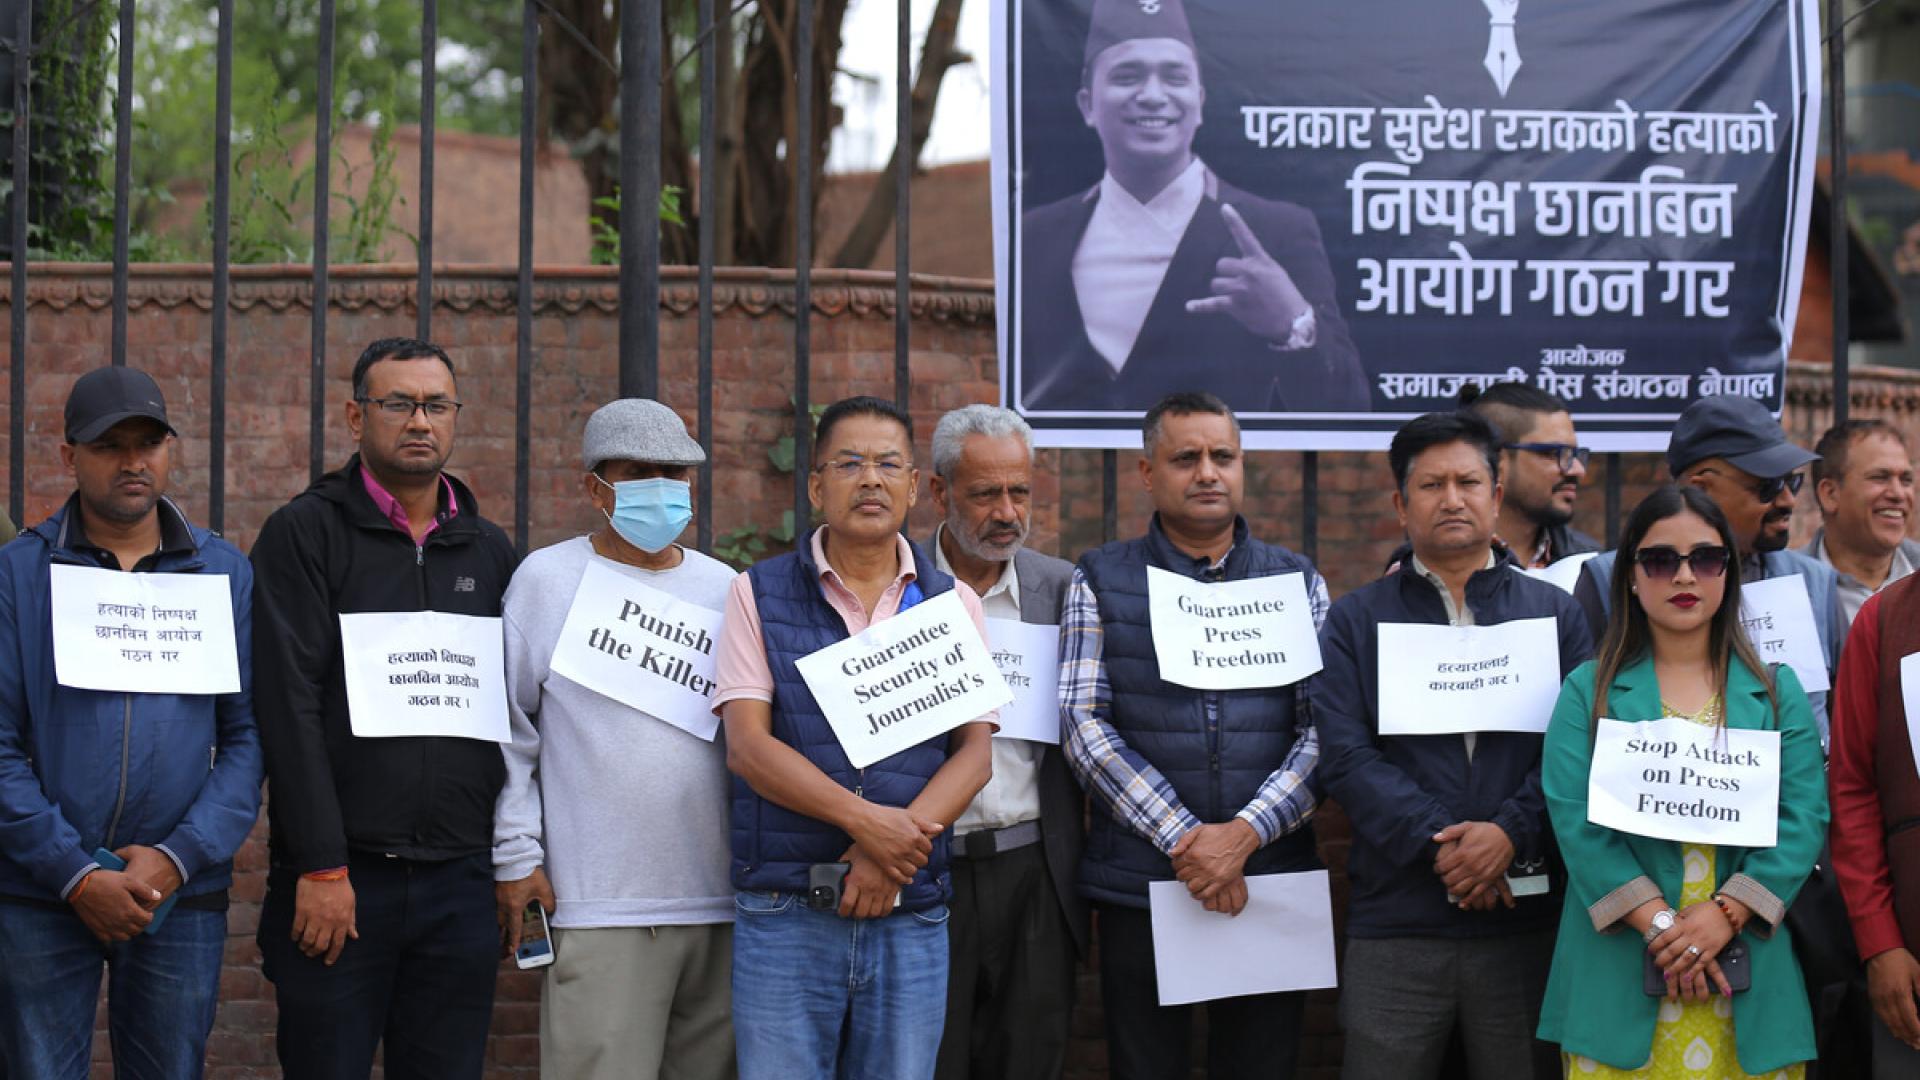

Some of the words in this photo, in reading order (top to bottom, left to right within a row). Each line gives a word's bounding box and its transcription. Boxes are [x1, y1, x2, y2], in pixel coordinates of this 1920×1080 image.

[1240, 105, 1375, 150] पत्रकार
[1381, 94, 1485, 166] सुरेश
[1490, 99, 1638, 153] रजकको
[1643, 100, 1778, 155] हत्याको
[1345, 161, 1521, 236] निष्पक्ष
[1528, 165, 1738, 239] छानबिन
[1355, 241, 1518, 317] आयोग
[1526, 260, 1650, 318] गठन
[1657, 261, 1735, 318] गर
[1540, 344, 1626, 367] आयोजक
[1592, 370, 1692, 401] संगठन
[1698, 366, 1776, 399] नेपाल
[97, 602, 146, 620] हत्याको
[1178, 595, 1286, 618] Guarantee
[617, 598, 713, 656] Punish
[1204, 627, 1262, 643] Press
[120, 649, 153, 663] गठन
[160, 651, 181, 663] गर
[588, 627, 633, 661] the
[638, 645, 718, 698] Killer
[841, 620, 951, 677] Guarantee
[1192, 650, 1288, 668] Freedom
[853, 658, 940, 704] Security
[943, 642, 967, 668] of
[866, 672, 985, 736] Journalist's
[1625, 739, 1678, 759] Stop
[1685, 742, 1761, 767] Attack
[1642, 767, 1671, 784] on
[1679, 766, 1741, 792] Press
[1636, 793, 1741, 822] Freedom
